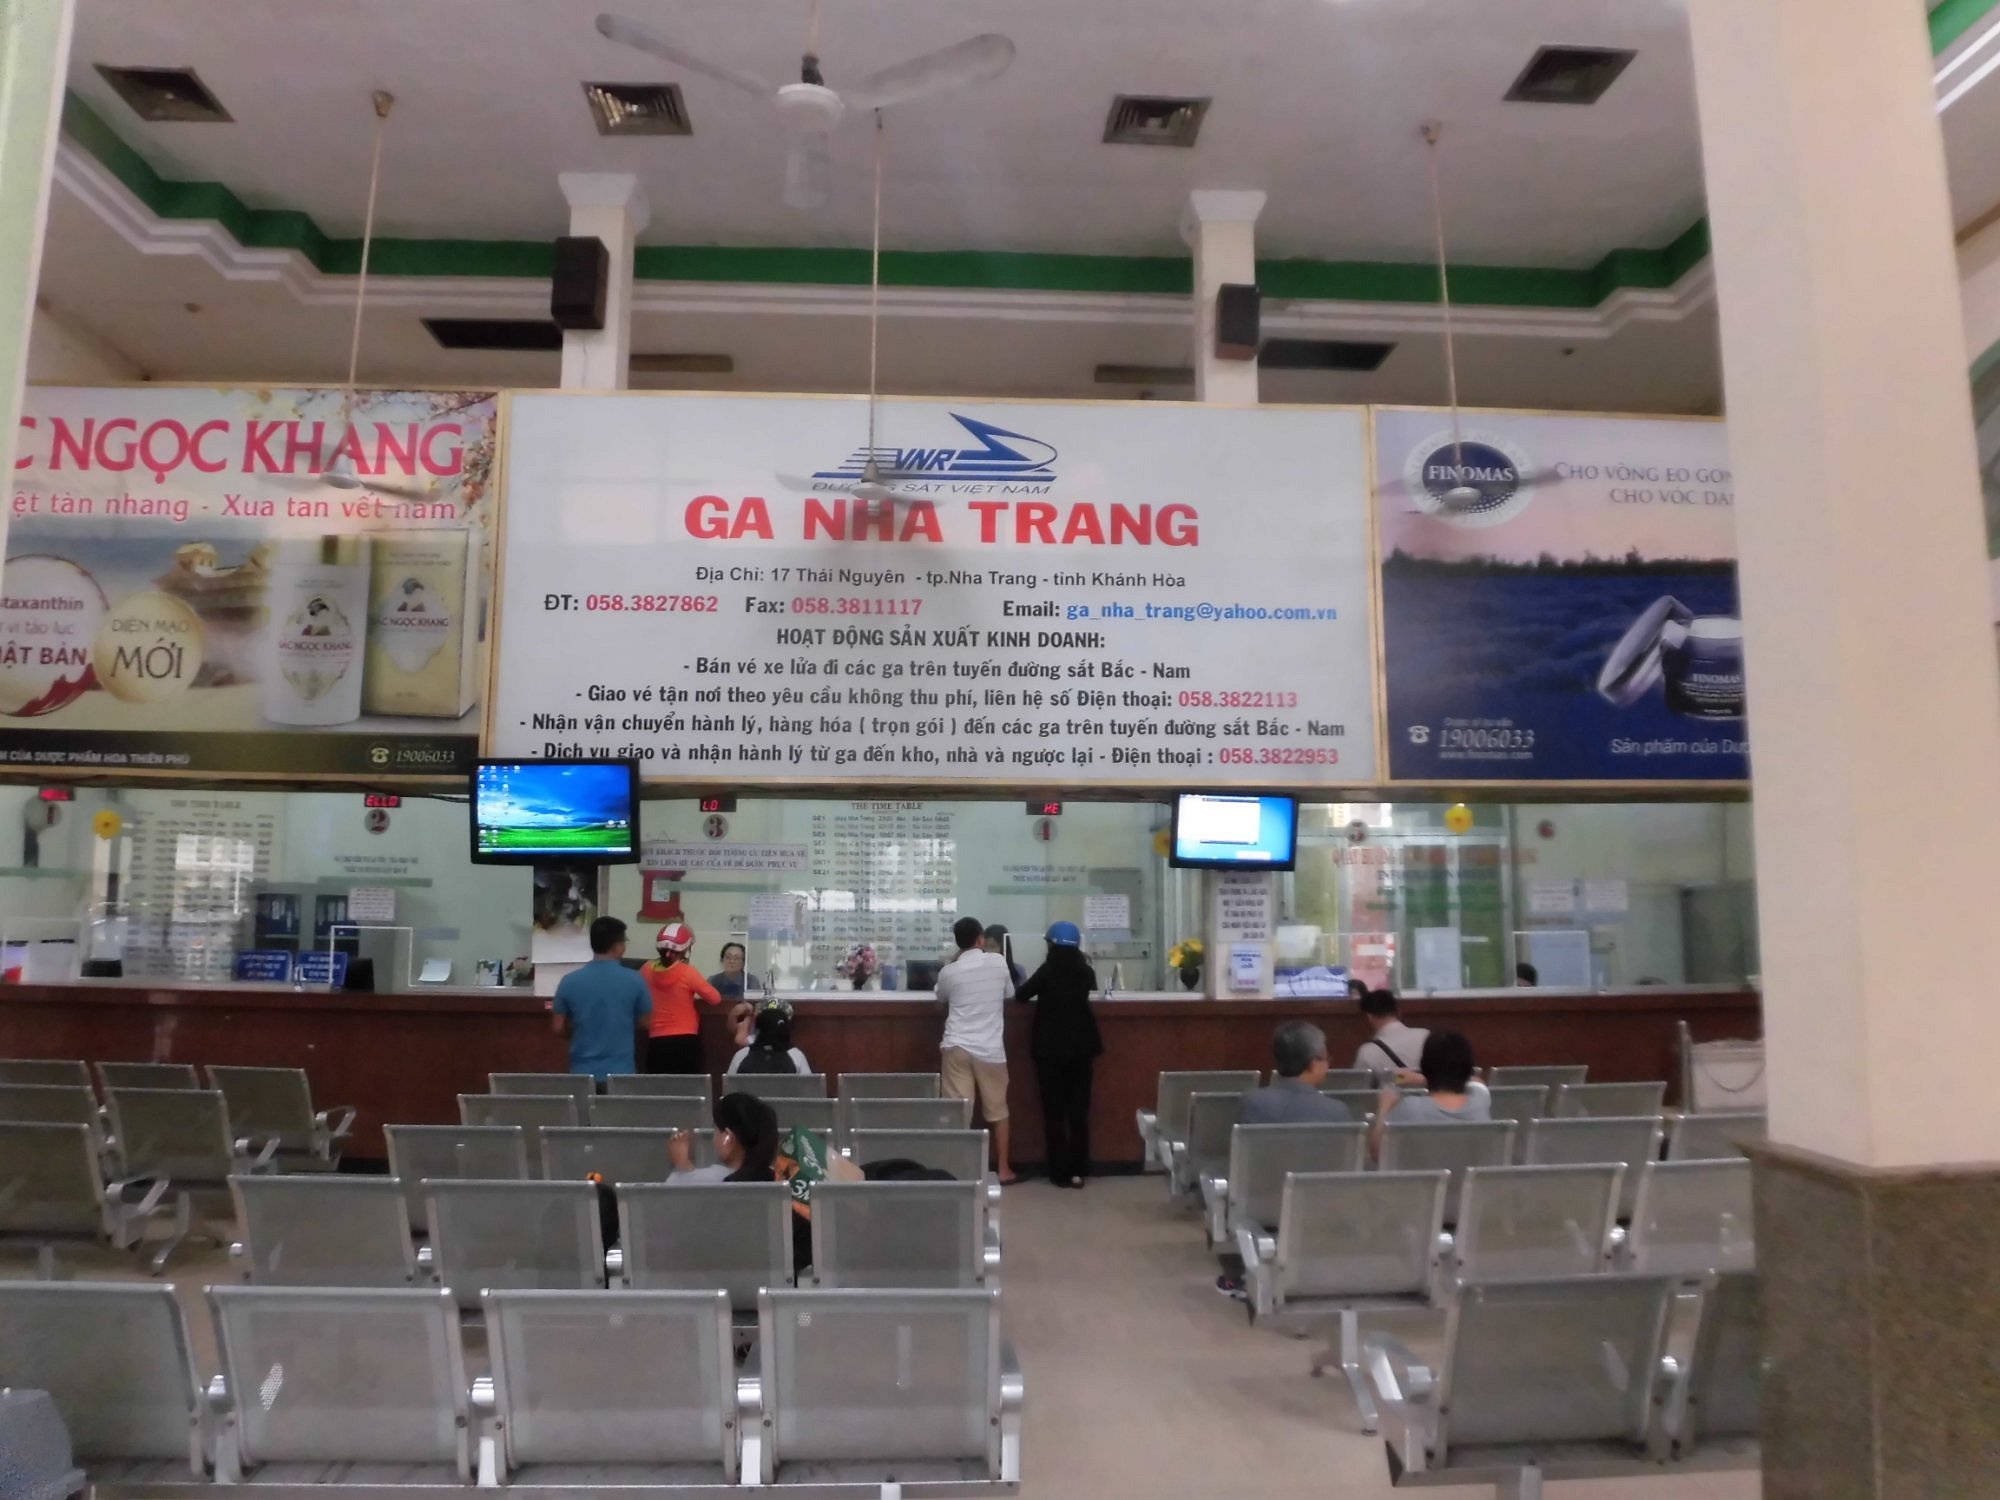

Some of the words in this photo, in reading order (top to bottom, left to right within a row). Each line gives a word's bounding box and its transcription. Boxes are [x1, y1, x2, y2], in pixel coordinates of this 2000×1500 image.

[48, 417, 230, 484] NGỌC
[241, 420, 465, 476] KHANG
[1428, 465, 1514, 482] FINOMAS
[51, 492, 92, 514] tàn
[105, 493, 189, 522] nhang
[222, 494, 274, 517] Xua
[287, 497, 328, 517] tan
[342, 492, 383, 519] vết
[685, 495, 774, 540] GA
[803, 498, 944, 542] NHA
[968, 501, 1199, 547] TRANG
[695, 566, 724, 584] Địa
[771, 567, 790, 582] 17
[796, 567, 833, 583] Thái
[839, 568, 905, 587] Nguyên
[926, 570, 982, 588] tp.Nha
[988, 571, 1037, 589] Trang
[1092, 572, 1147, 587] Khánh
[544, 594, 580, 612] ĐT:
[586, 594, 719, 612] 058.3827862
[745, 597, 785, 614] Fax:
[792, 598, 922, 616] 058.3811117
[1003, 600, 1060, 618] Email:
[1066, 602, 1338, 623] ga_nha_trang@yahoo.com.vn
[777, 628, 826, 649] HOẠT
[833, 625, 884, 650] ĐỘNG
[890, 624, 926, 647] SẢN
[933, 624, 980, 648] XUẤT
[987, 631, 1031, 648] KINH
[1038, 631, 1106, 648] DOANH:
[110, 637, 184, 679] MỚI
[696, 657, 731, 674] Bán
[737, 658, 757, 674] vé
[764, 662, 784, 675] xe
[823, 658, 839, 675] đi
[845, 659, 876, 676] các
[882, 664, 904, 680] ga
[909, 661, 946, 677] trên
[953, 659, 1001, 681] tuyến
[1008, 661, 1061, 681] đường
[1068, 659, 1096, 678] sắt
[1101, 659, 1135, 678] Bắc
[1153, 662, 1192, 678] Nam
[588, 685, 626, 702] Giao
[633, 685, 652, 702] vé
[659, 685, 688, 705] tận
[695, 686, 721, 703] nơi
[727, 686, 767, 703] theo
[772, 688, 804, 707] yêu
[810, 684, 842, 705] cầu
[848, 687, 904, 708] không
[909, 689, 938, 705] thu
[945, 689, 978, 710] phí,
[984, 689, 1016, 706] liên
[1022, 690, 1043, 710] hệ
[1050, 688, 1070, 706] số
[1077, 690, 1117, 711] Điện
[1122, 690, 1173, 710] thoại:
[1178, 691, 1298, 708] 058.3822113
[532, 713, 578, 734] Nhận
[584, 714, 616, 734] vận
[622, 711, 685, 735] chuyển
[692, 714, 735, 732] hành
[742, 715, 763, 736] lý,
[770, 715, 814, 736] hàng
[820, 716, 852, 733] hóa
[871, 718, 910, 738] trọn
[916, 718, 944, 736] gói
[963, 715, 996, 735] đến
[1002, 718, 1033, 735] các
[1039, 722, 1060, 737] ga
[1066, 719, 1104, 736] trên
[1109, 717, 1158, 738] tuyến
[1164, 719, 1217, 739] đường
[1222, 717, 1250, 736] sắt
[1256, 717, 1289, 736] Bắc
[1308, 720, 1345, 736] Nam
[1440, 729, 1535, 748] 19006033
[397, 750, 456, 762] 19006033
[661, 744, 680, 761] và
[688, 744, 732, 765] nhận
[738, 744, 782, 762] hành
[788, 745, 804, 765] lý
[810, 745, 829, 762] từ
[835, 750, 857, 765] ga
[863, 744, 896, 763] đến
[902, 746, 939, 765] kho,
[946, 746, 979, 763] nhà
[985, 747, 1005, 763] và
[1012, 748, 1066, 767] ngược
[1072, 747, 1093, 767] lại
[1111, 747, 1152, 768] Điện
[1157, 748, 1202, 768] thoại
[1219, 749, 1339, 765] 058.3822953
[708, 816, 724, 838] 3
